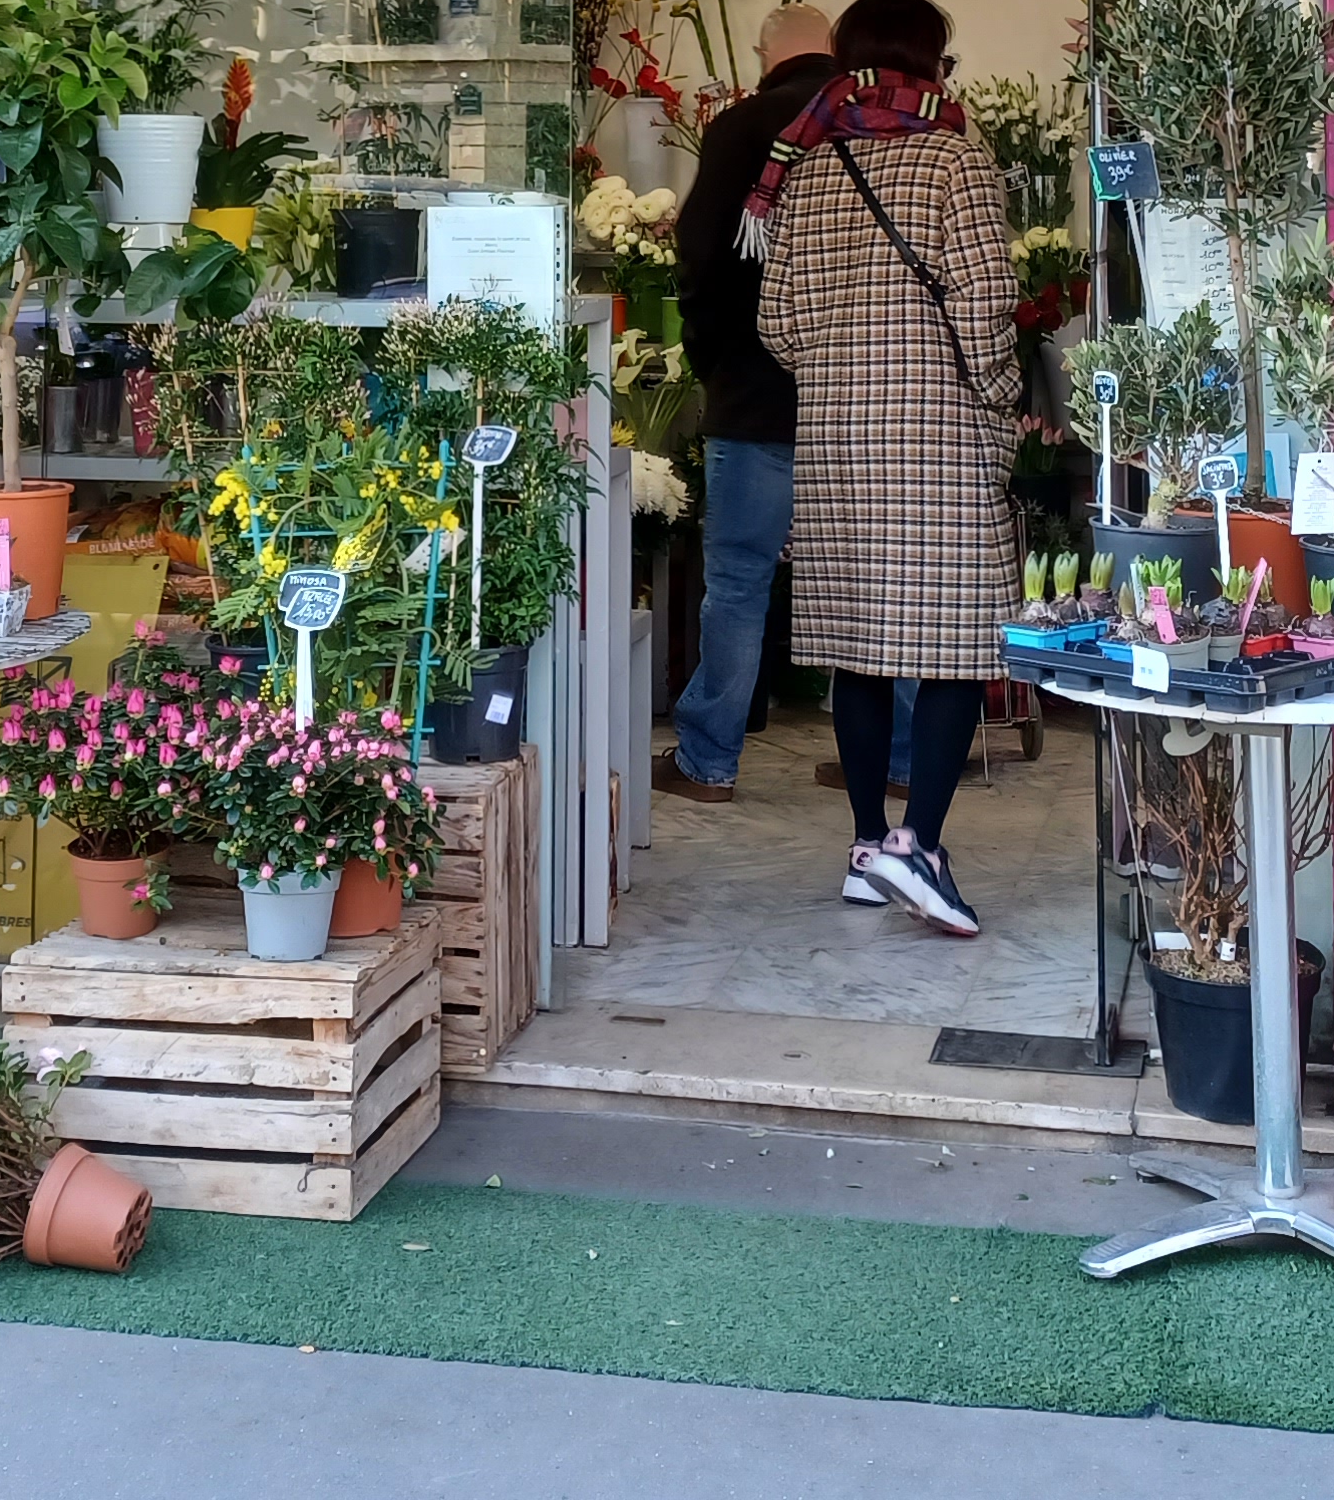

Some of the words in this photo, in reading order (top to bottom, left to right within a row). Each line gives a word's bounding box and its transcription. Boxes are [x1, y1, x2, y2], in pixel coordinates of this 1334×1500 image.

[1107, 164, 1135, 186] 39€
[1210, 471, 1226, 489] 3€
[289, 575, 327, 586] MIMOSA
